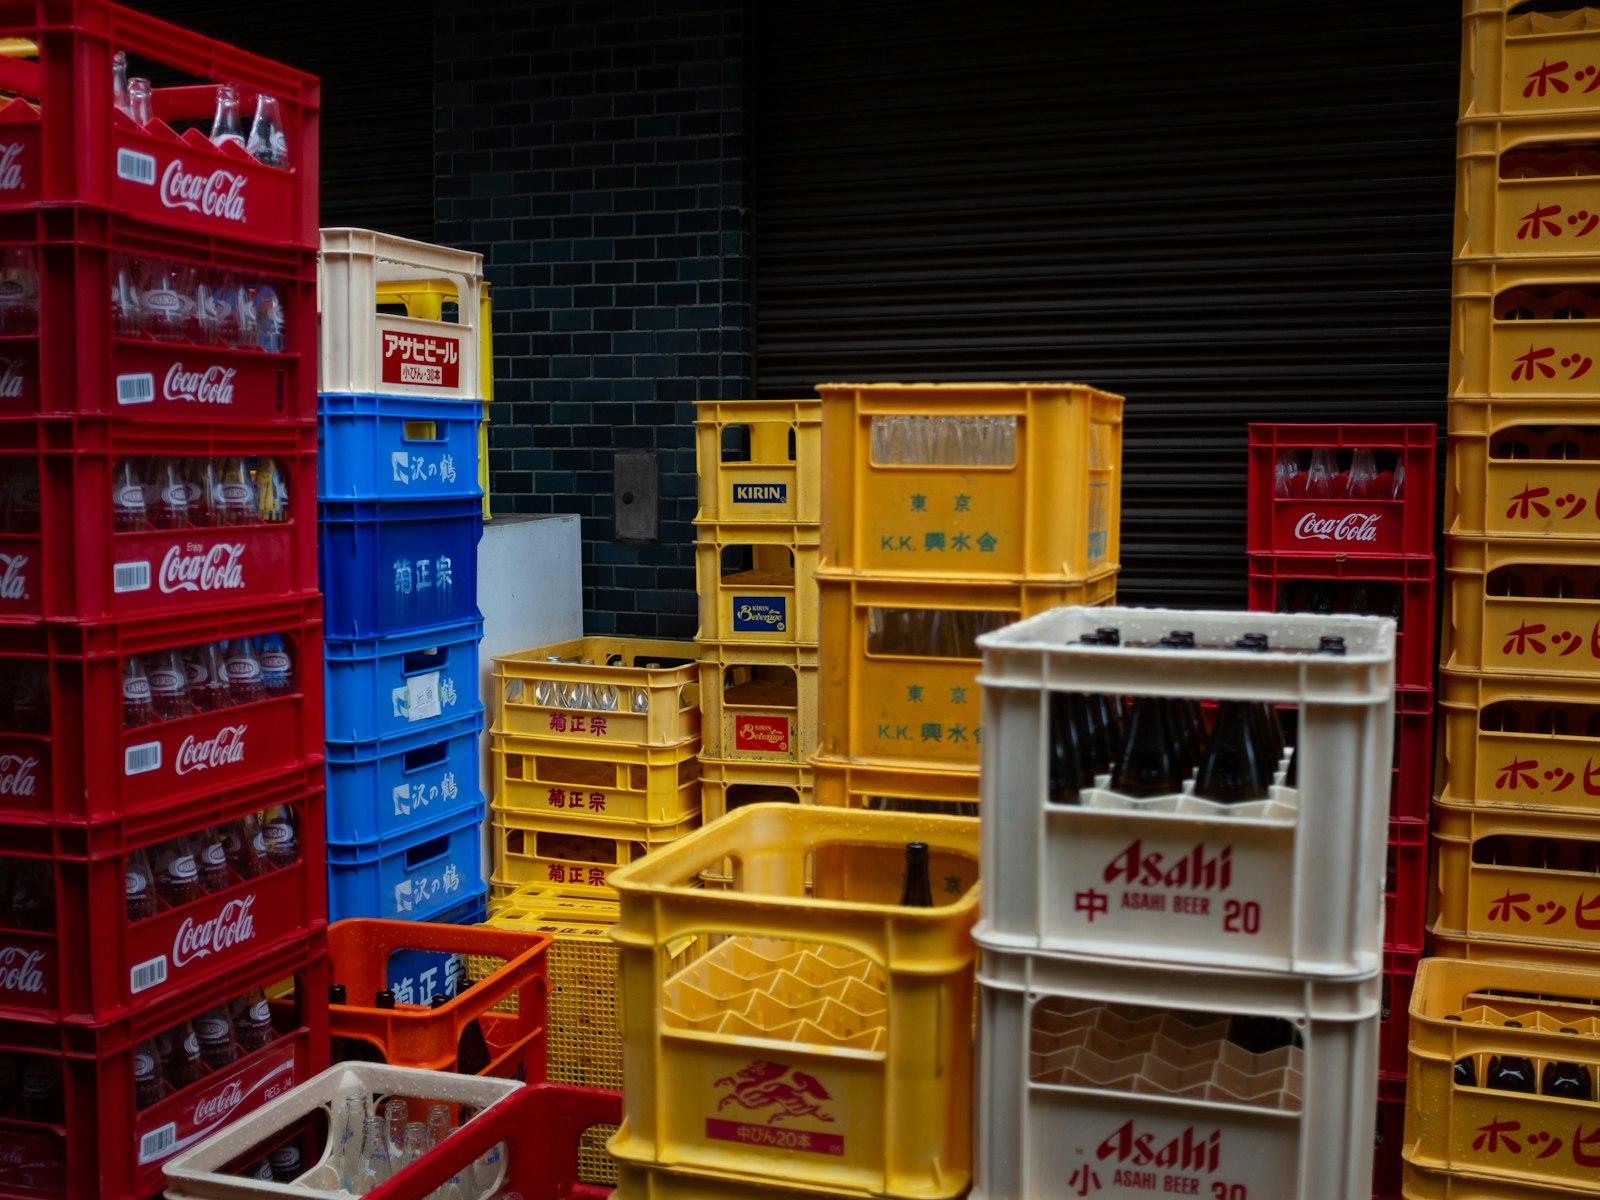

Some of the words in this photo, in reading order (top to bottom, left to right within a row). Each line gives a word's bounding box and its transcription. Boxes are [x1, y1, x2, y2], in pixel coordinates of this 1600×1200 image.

[160, 159, 247, 222] Coca-Cola
[384, 334, 457, 364] アサヒビール
[1511, 344, 1592, 381] ホッ
[163, 362, 238, 404] Coca-Cola
[411, 454, 456, 483] 沢の鶴
[737, 487, 780, 499] KIRIN
[1506, 482, 1600, 519] ホッ
[881, 535, 916, 551] K.K.
[1294, 512, 1382, 541] Coca-Cola
[186, 542, 203, 553] Enjoy
[160, 543, 245, 593] Coca-Cola
[393, 556, 452, 594] 菊正宗
[1502, 618, 1600, 659] ホッ
[549, 713, 607, 737] 菊正宗
[176, 724, 248, 776] Coca-Cola
[411, 772, 459, 809] 沢の鶴
[548, 788, 606, 812] 菊正宗
[548, 863, 606, 886] 菊正宗
[1104, 839, 1232, 892] Asahi
[413, 863, 460, 908] 沢の鶴
[1074, 888, 1108, 922] 中
[1121, 892, 1166, 912] ASAHI
[1172, 895, 1211, 915] BEER
[1223, 900, 1260, 935] 20
[173, 894, 256, 968] Coca-Cola
[737, 1126, 812, 1149] 中びん20本
[1096, 1119, 1221, 1174] Asahi
[1067, 1164, 1102, 1196] 小
[1112, 1169, 1157, 1191] ASAHI
[1162, 1175, 1201, 1196] BEER
